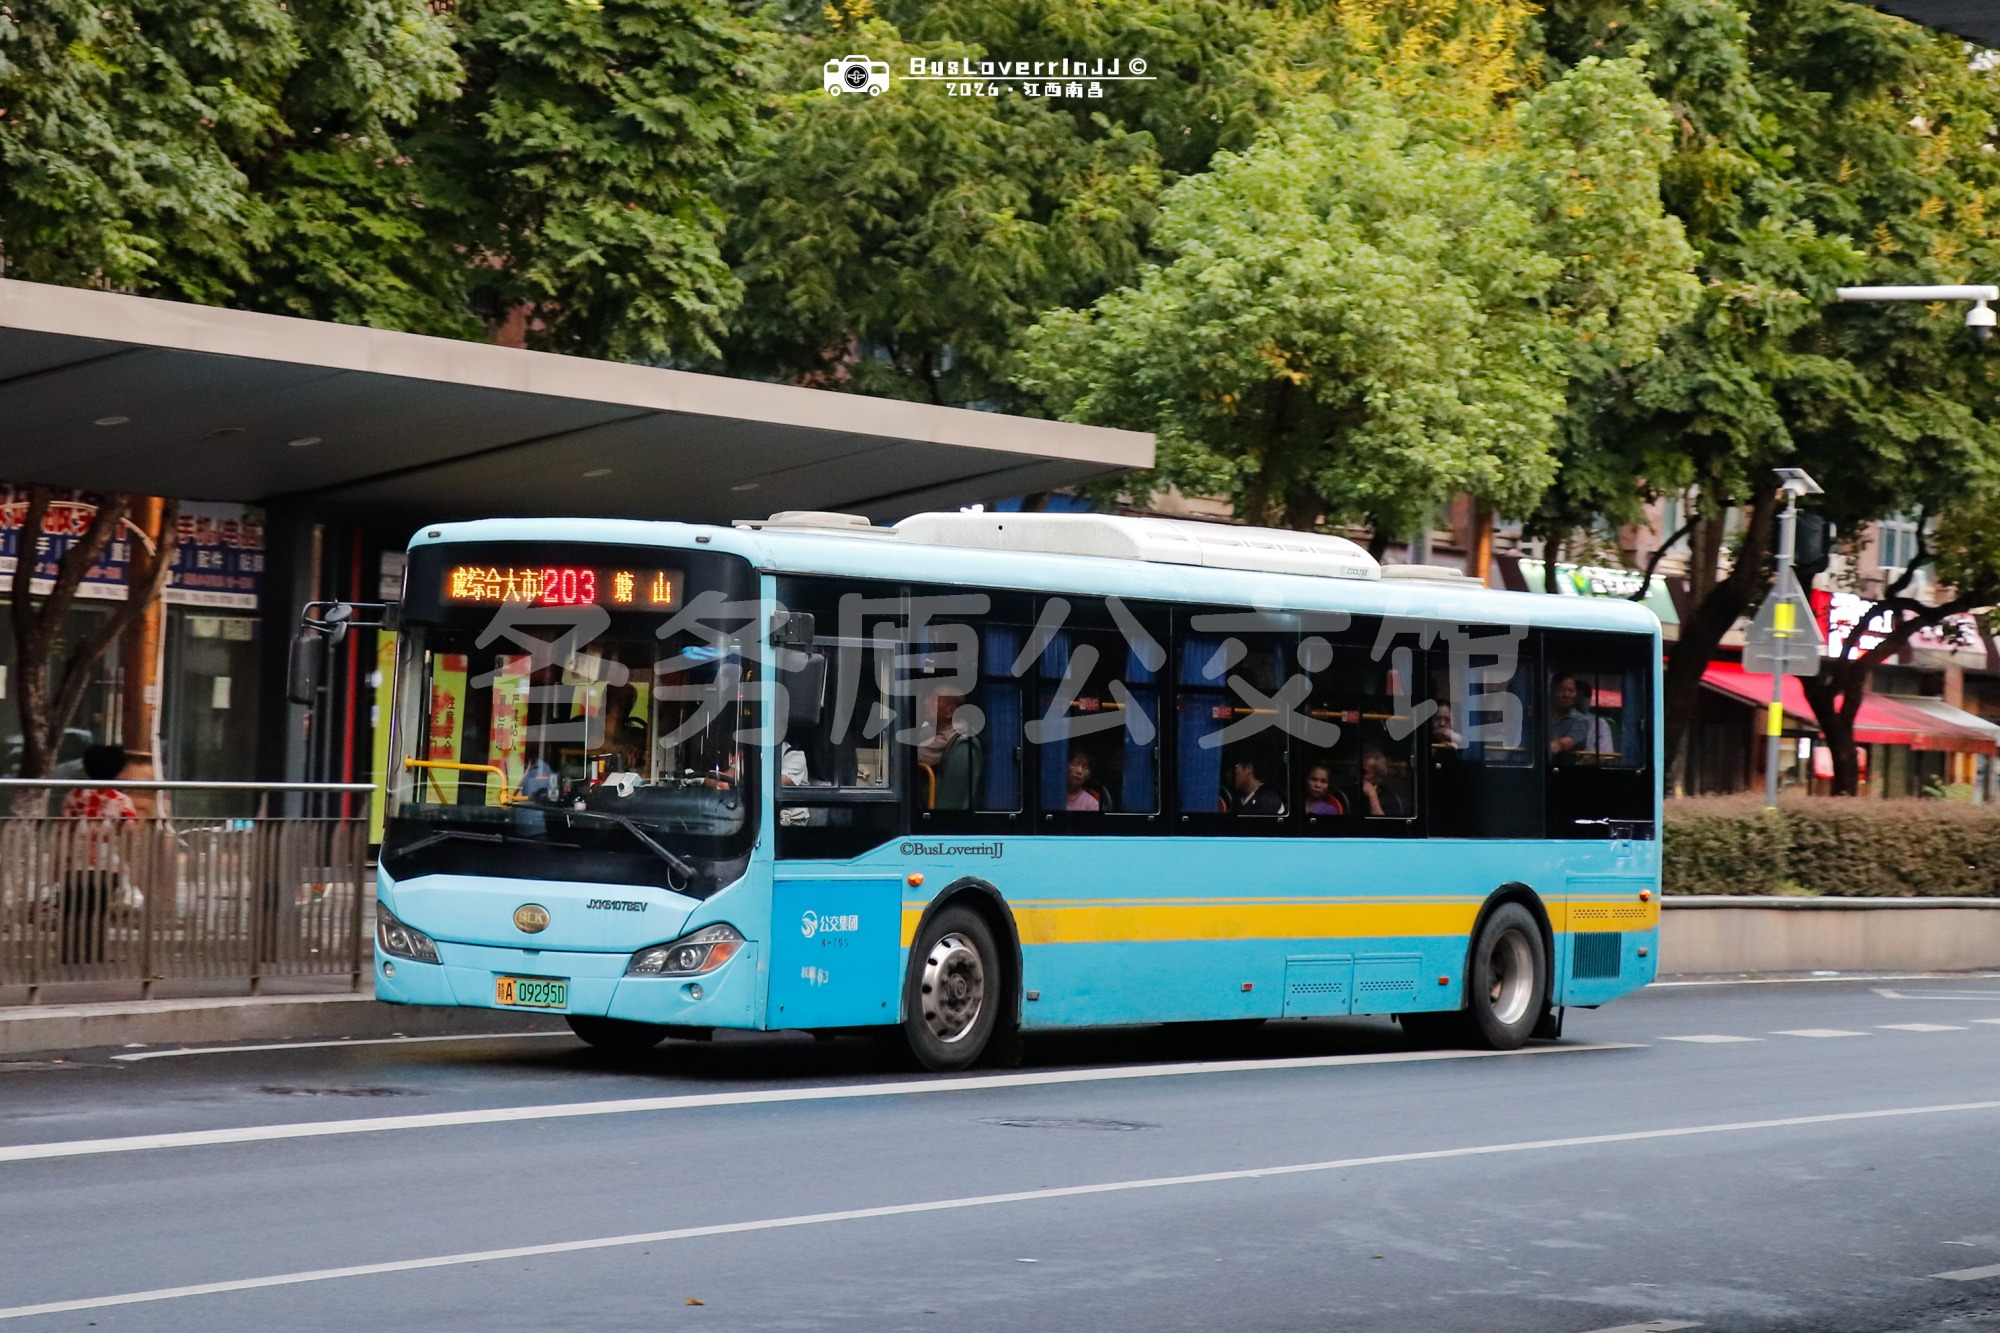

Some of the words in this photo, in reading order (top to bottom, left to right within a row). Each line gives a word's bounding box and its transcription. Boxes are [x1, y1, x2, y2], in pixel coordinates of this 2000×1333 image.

[544, 569, 596, 604] 203
[820, 915, 858, 932] 公交集团
